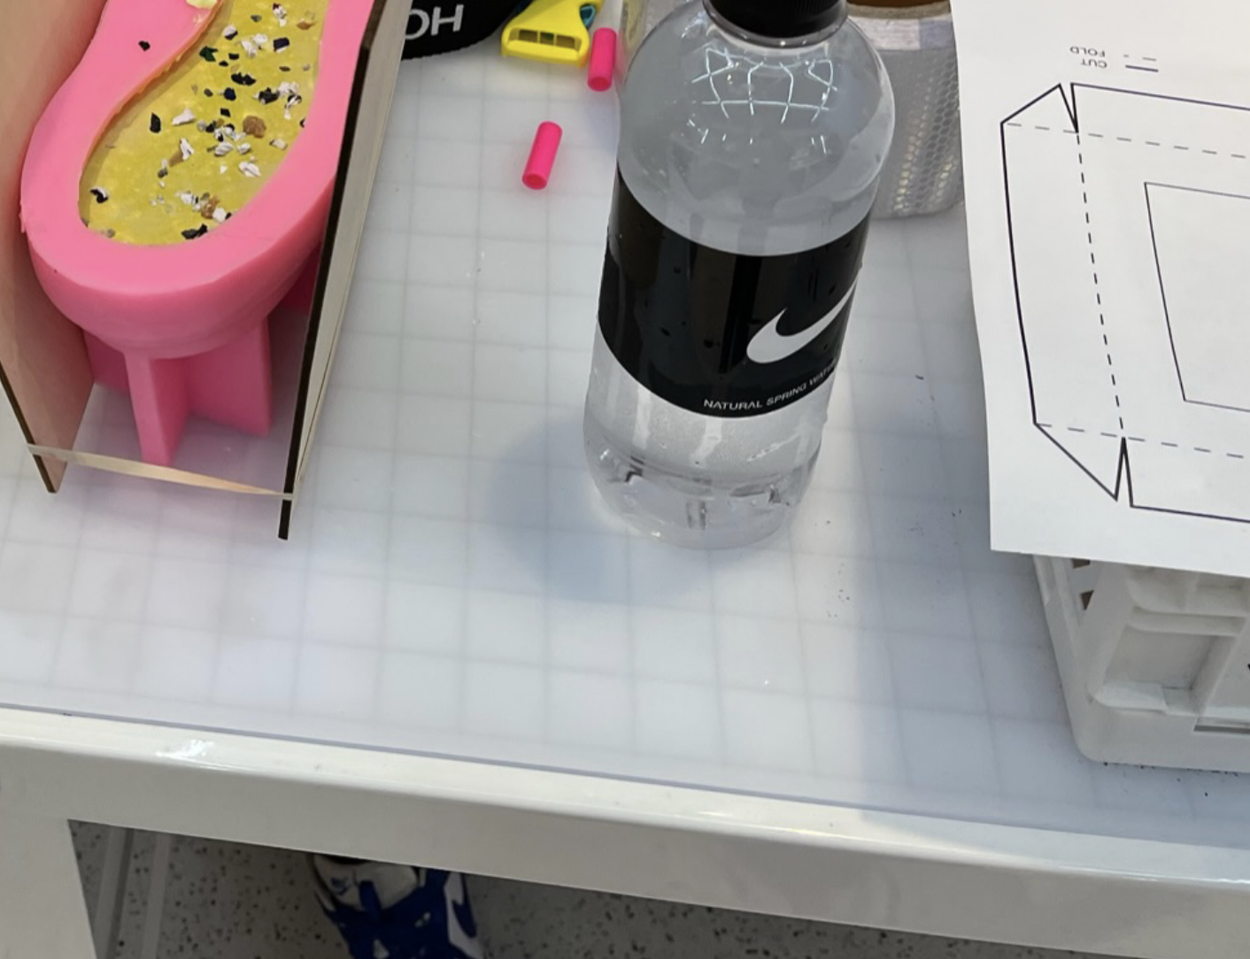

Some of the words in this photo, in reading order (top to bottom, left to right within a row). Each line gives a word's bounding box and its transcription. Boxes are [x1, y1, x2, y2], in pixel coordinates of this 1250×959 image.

[1069, 45, 1106, 58] FOLD
[1081, 58, 1108, 69] CUT
[703, 398, 763, 411] NATURAL
[766, 383, 807, 406] SPRING
